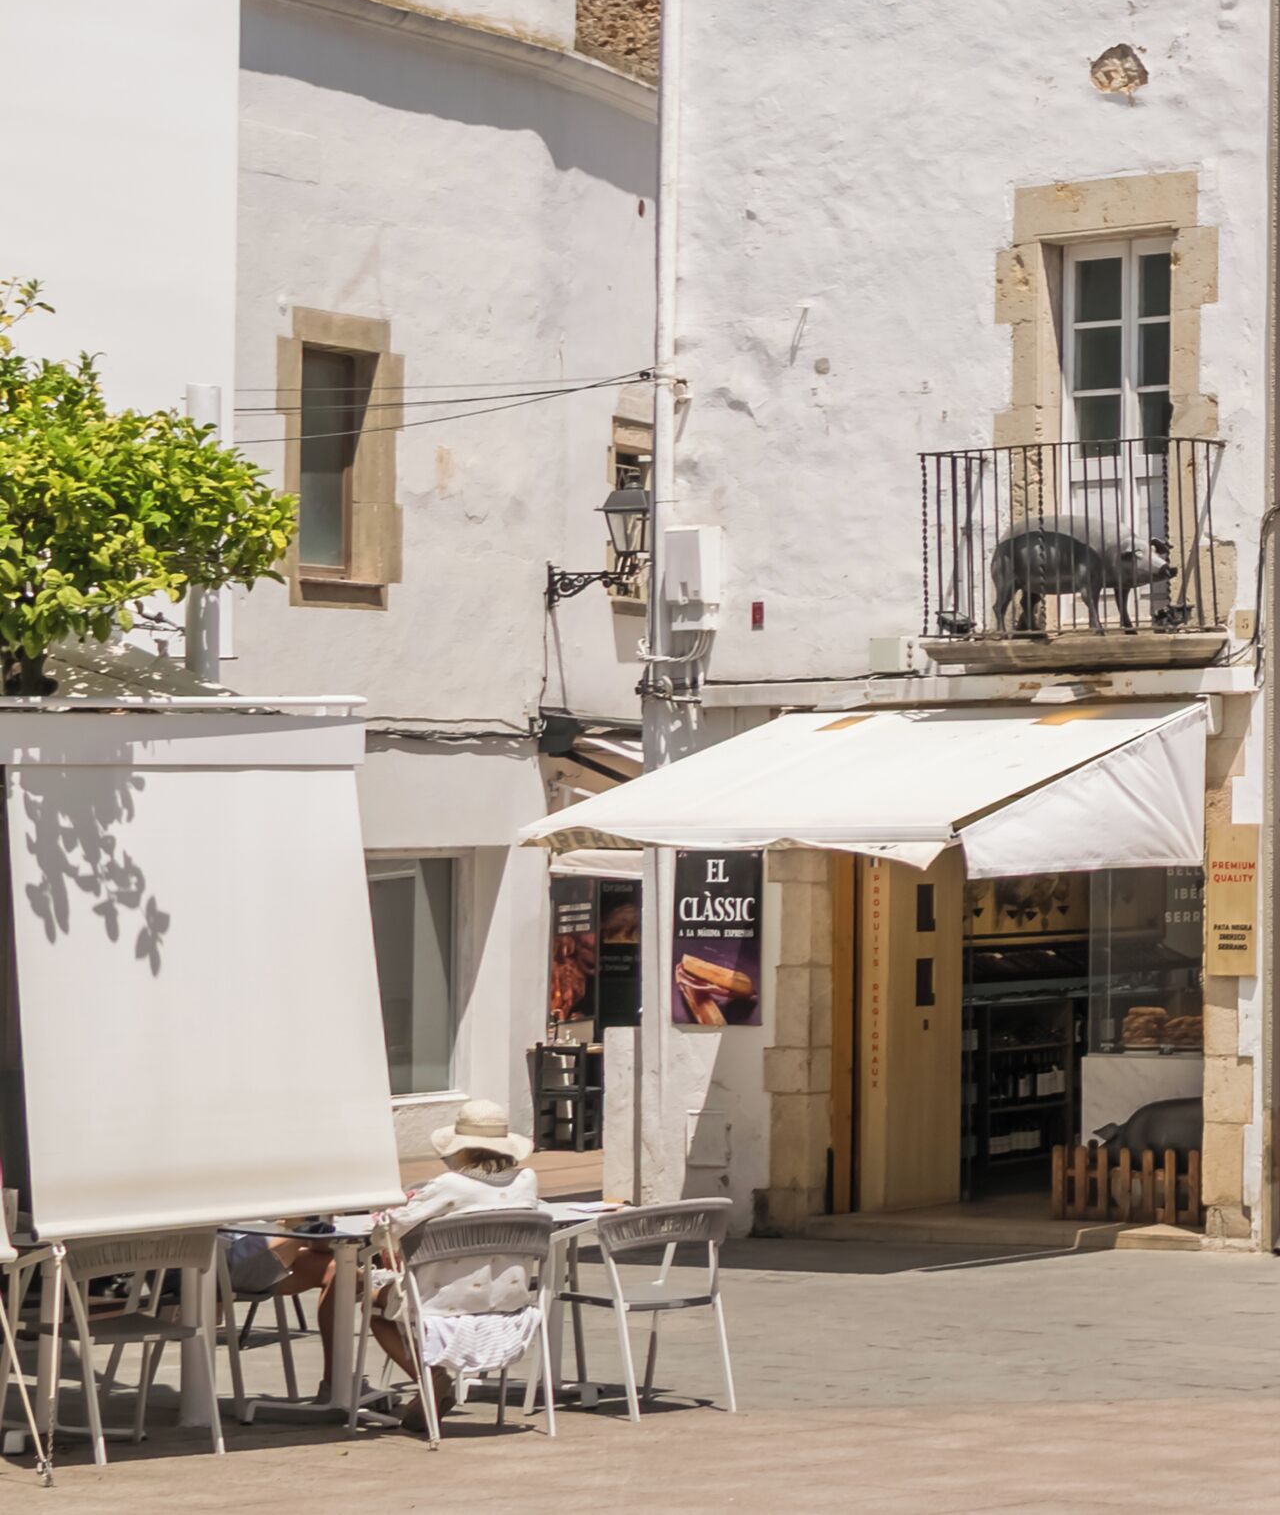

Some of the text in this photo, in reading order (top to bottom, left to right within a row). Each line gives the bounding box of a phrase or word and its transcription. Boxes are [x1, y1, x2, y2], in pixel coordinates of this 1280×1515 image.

[705, 859, 729, 883] EL
[1212, 861, 1256, 870] PREMIUM
[1213, 874, 1254, 883] QUALITY
[679, 891, 755, 922] CLÀSSIC
